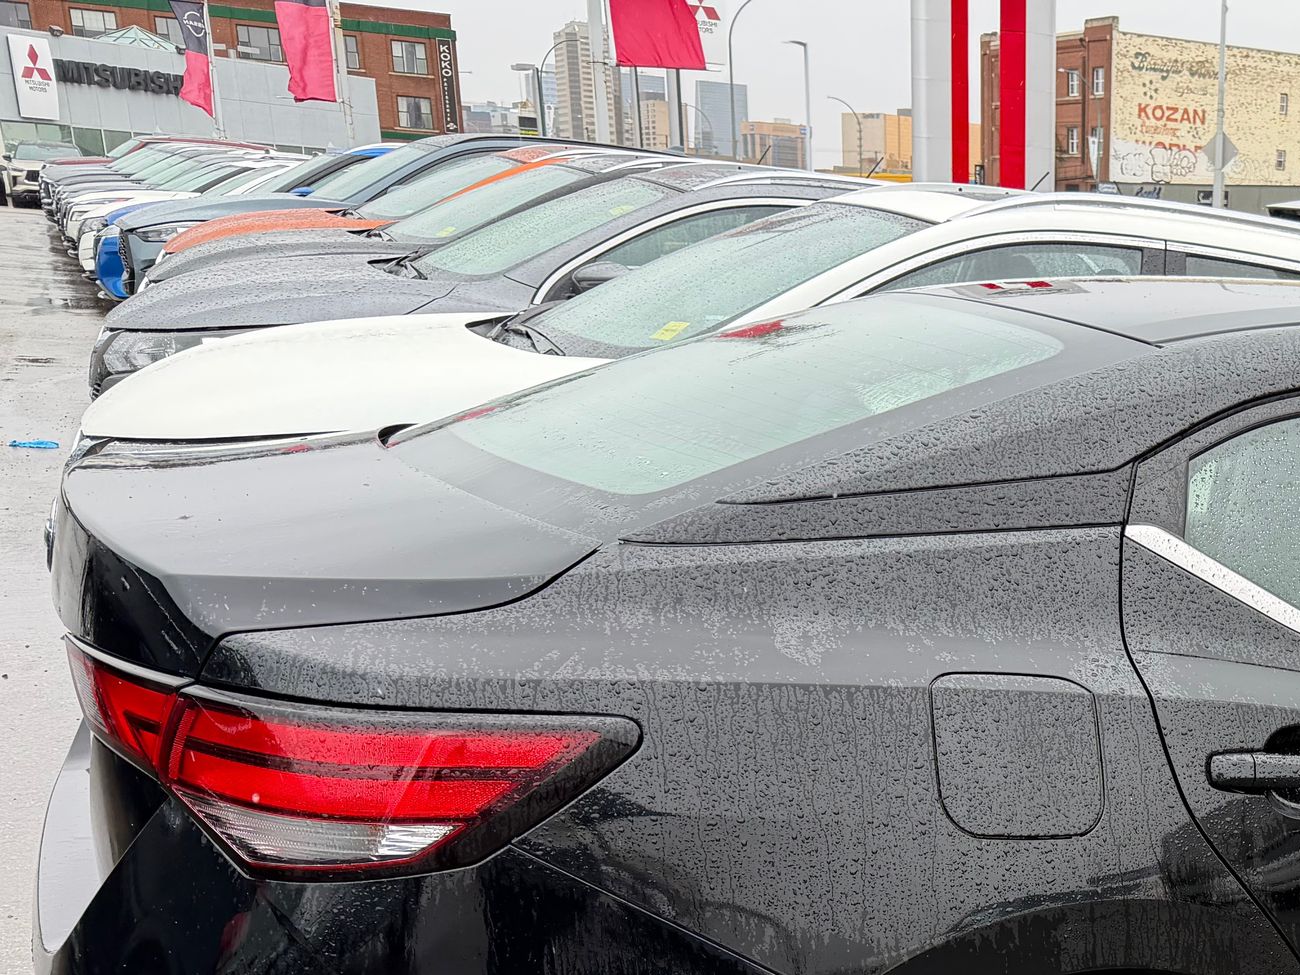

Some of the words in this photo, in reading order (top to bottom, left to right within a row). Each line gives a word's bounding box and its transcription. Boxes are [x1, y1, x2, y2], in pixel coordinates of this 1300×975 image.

[53, 58, 184, 96] MITSUBISH
[440, 45, 452, 77] KOKO
[1137, 102, 1206, 125] KOZAN
